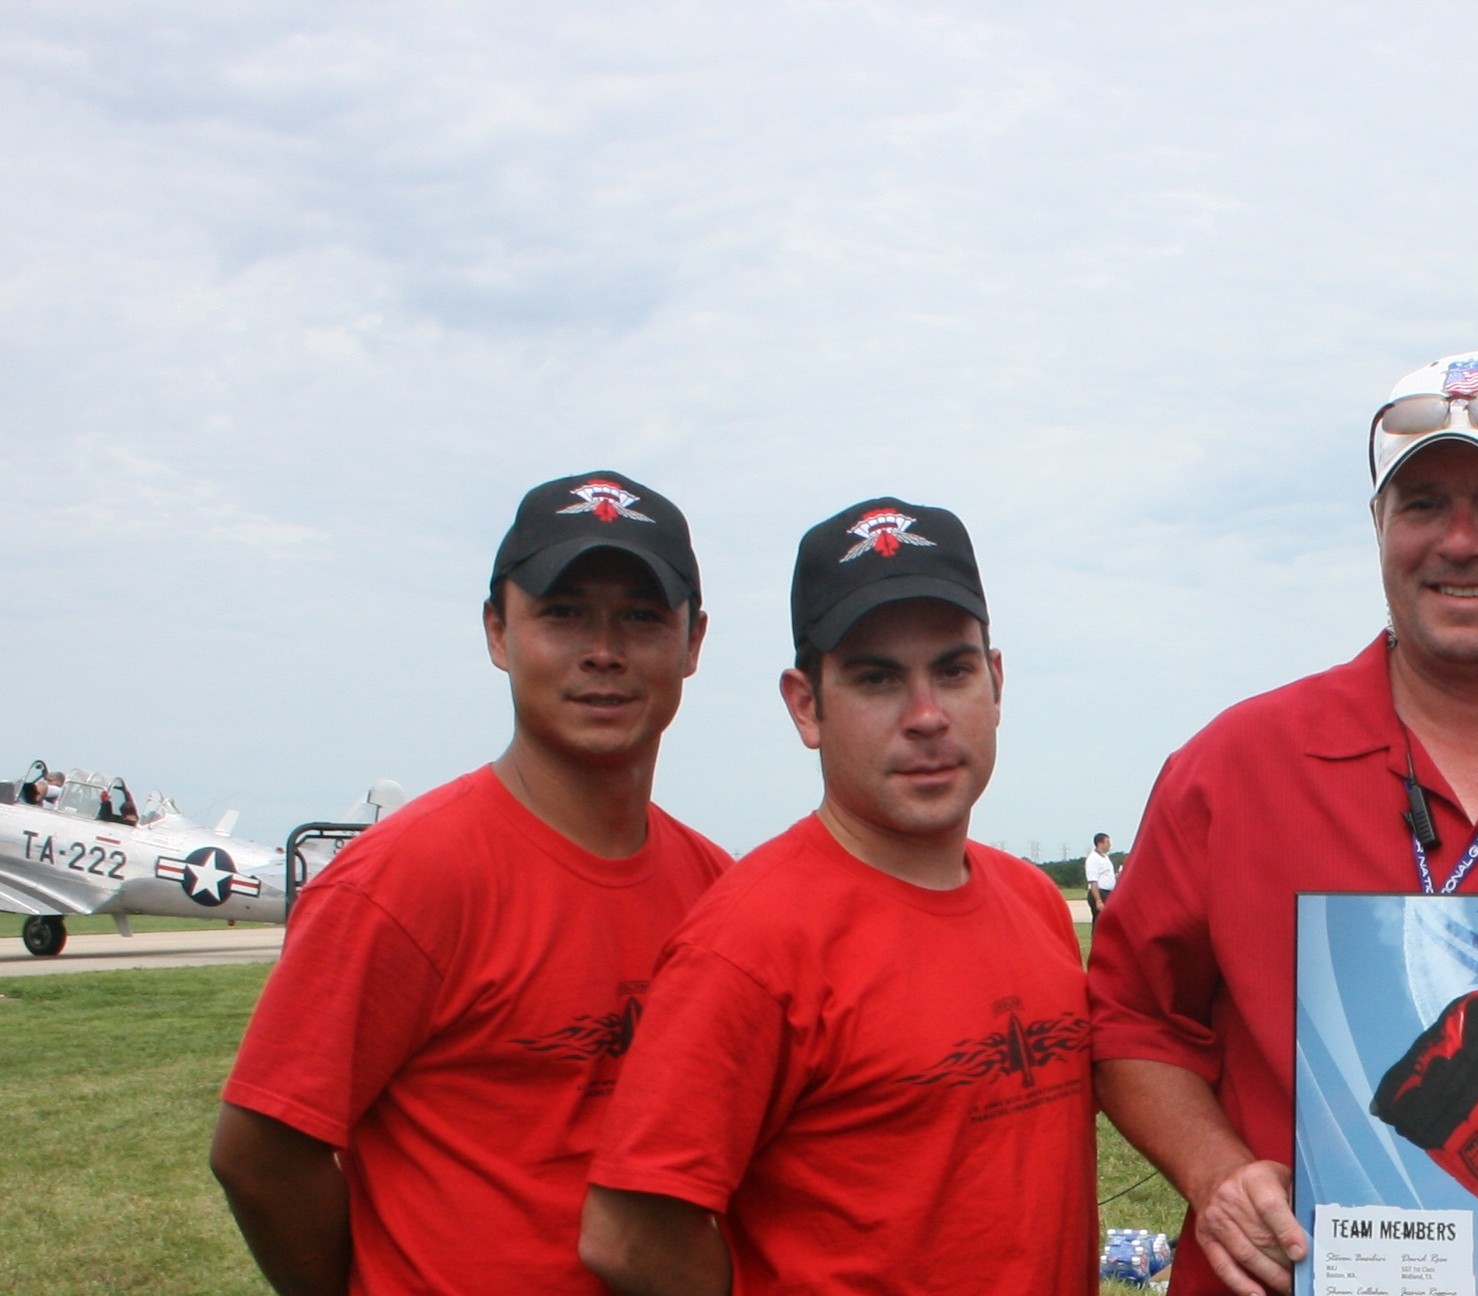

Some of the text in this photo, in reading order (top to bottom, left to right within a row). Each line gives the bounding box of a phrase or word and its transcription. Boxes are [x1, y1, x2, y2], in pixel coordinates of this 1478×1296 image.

[23, 830, 127, 880] TA-222
[1331, 1219, 1456, 1241] TEAM MEMBERS
